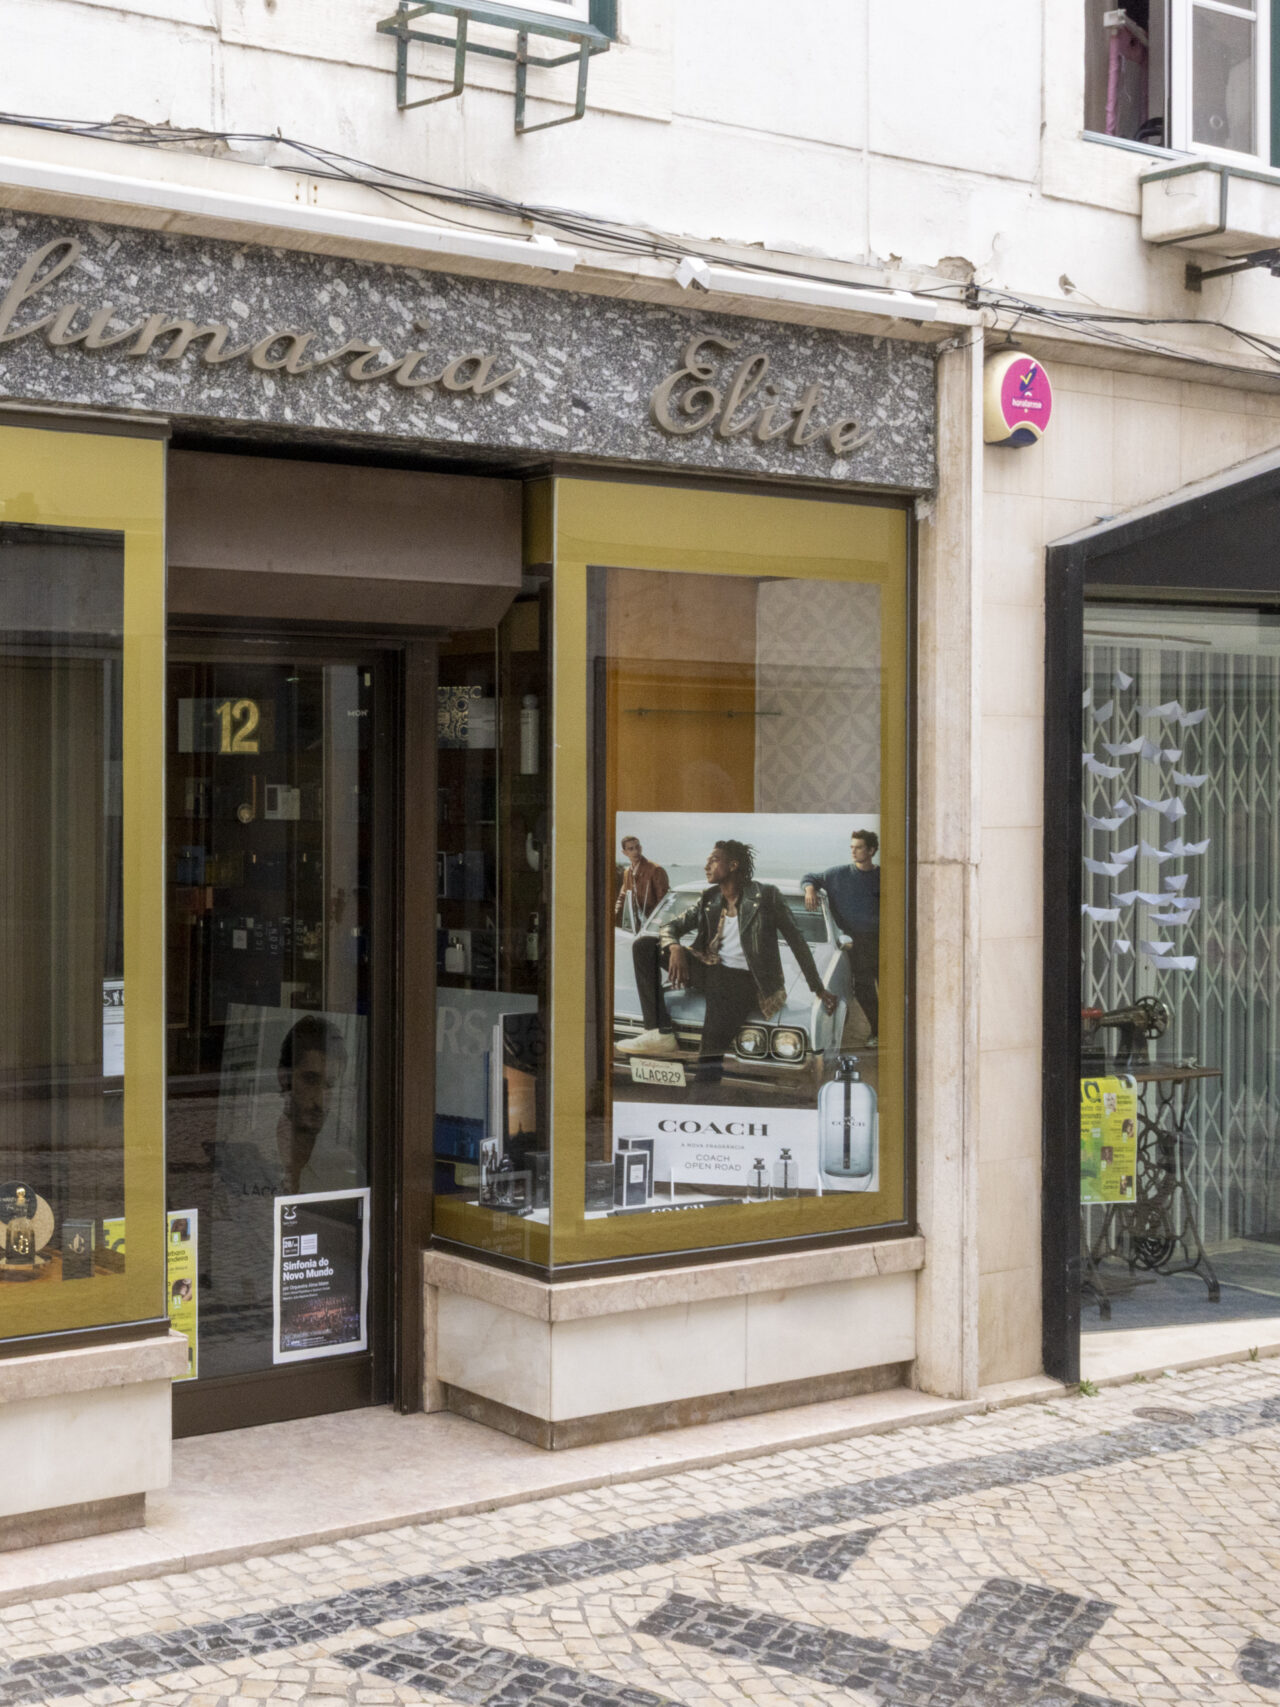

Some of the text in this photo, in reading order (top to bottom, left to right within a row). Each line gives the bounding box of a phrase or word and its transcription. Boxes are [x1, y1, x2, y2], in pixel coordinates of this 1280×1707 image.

[651, 335, 873, 453] Elite
[216, 699, 260, 754] 12
[658, 1119, 769, 1137] COACH
[695, 1153, 730, 1162] COACH
[684, 1161, 742, 1171] OPEN ROAD
[283, 1257, 329, 1272] Sinfonia do
[283, 1267, 334, 1282] Novo Mundo
